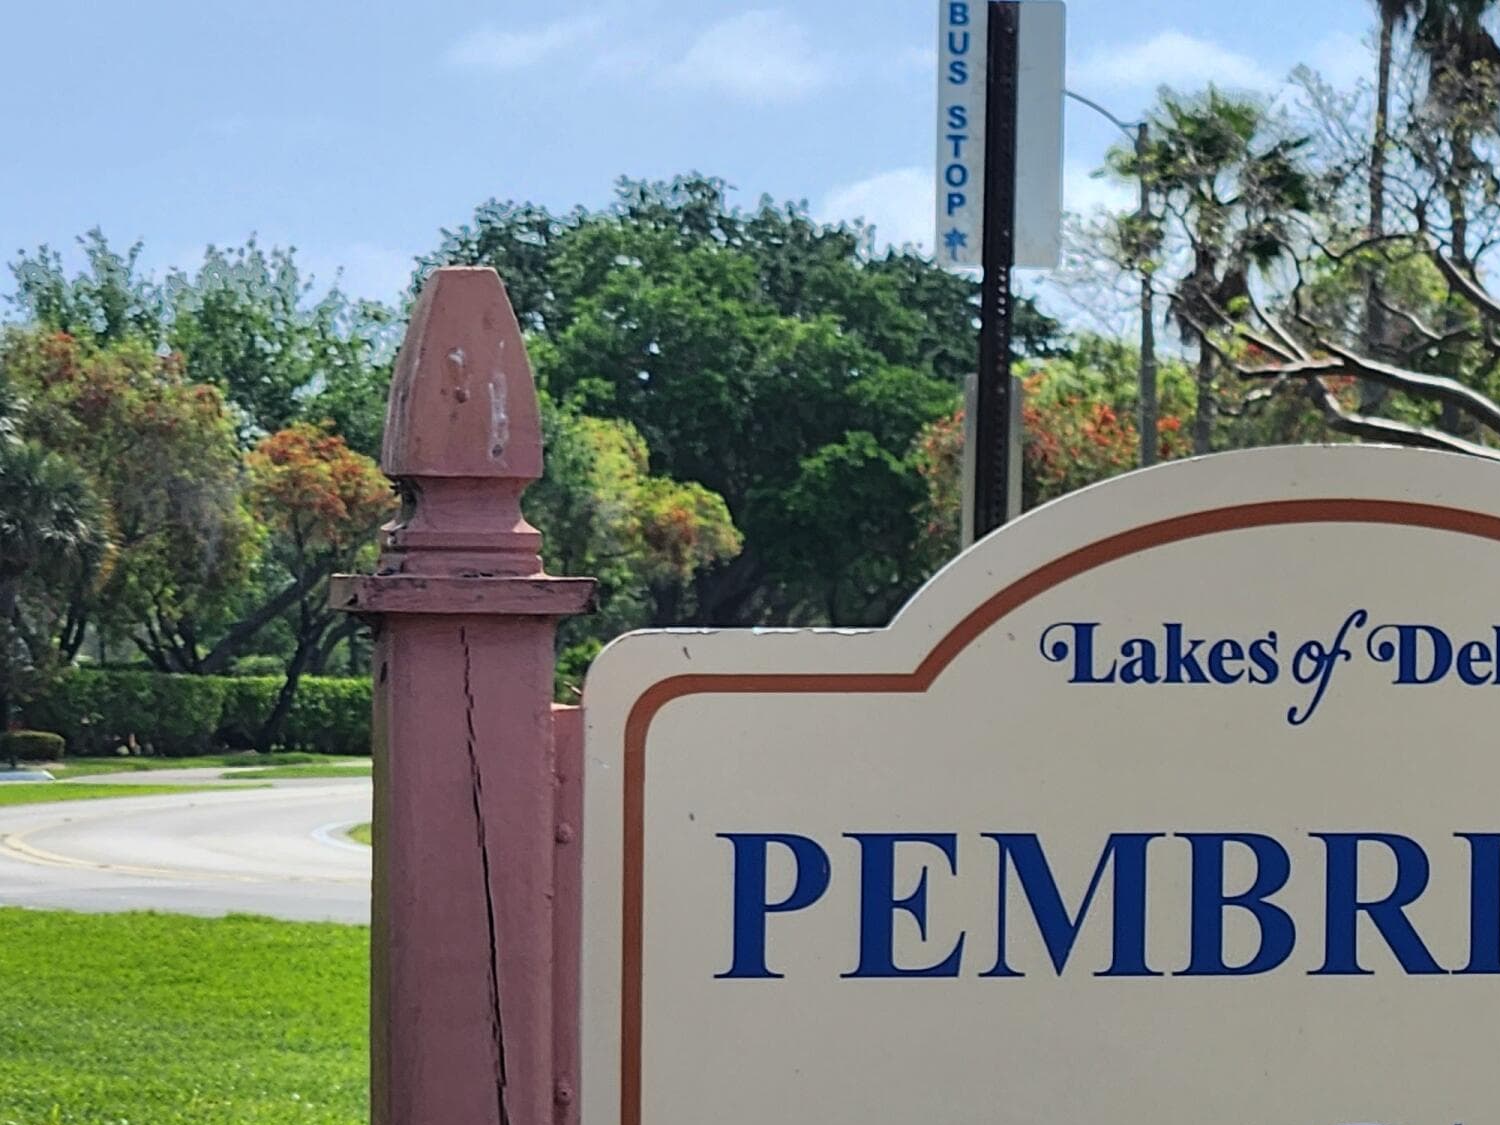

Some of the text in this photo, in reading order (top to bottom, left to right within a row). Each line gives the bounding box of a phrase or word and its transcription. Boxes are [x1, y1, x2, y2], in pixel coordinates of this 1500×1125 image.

[945, 2, 970, 216] BUS STOP
[1040, 622, 1280, 685] Lakes
[1286, 609, 1368, 725] of
